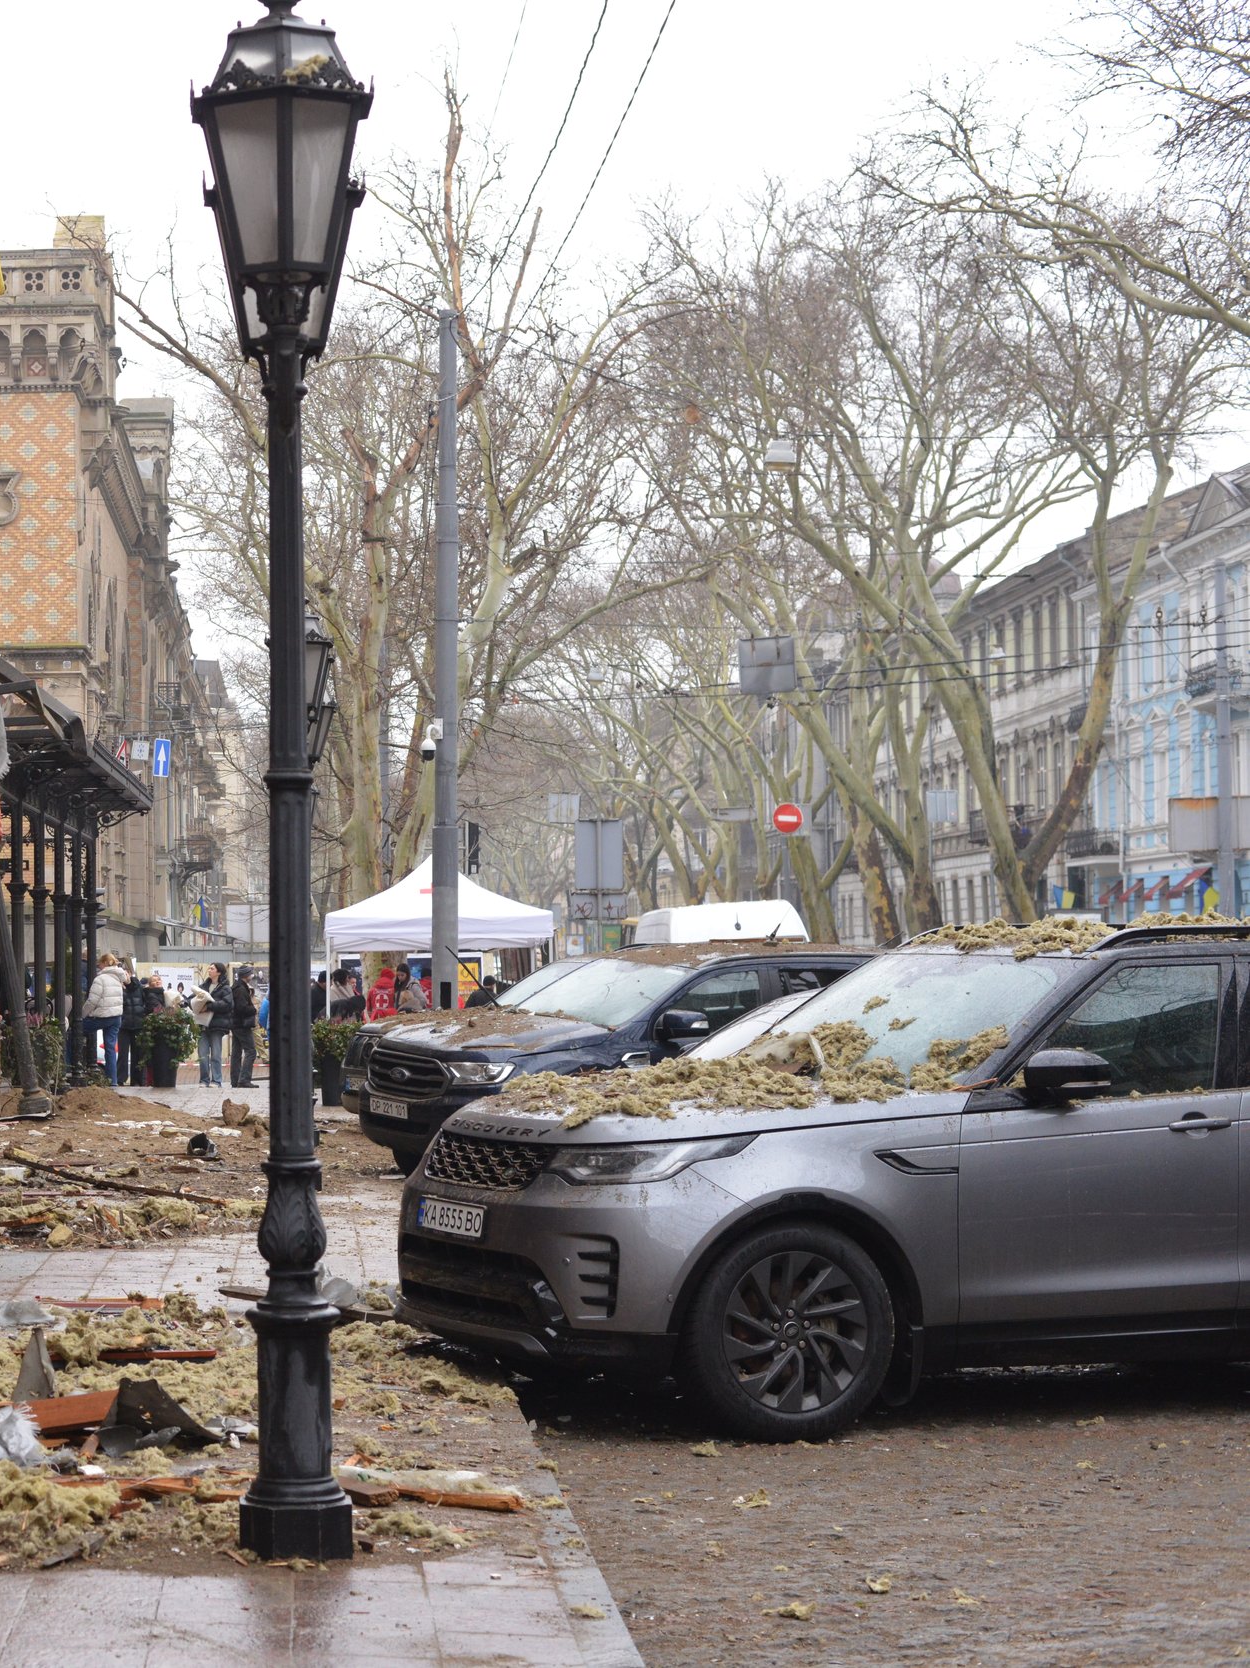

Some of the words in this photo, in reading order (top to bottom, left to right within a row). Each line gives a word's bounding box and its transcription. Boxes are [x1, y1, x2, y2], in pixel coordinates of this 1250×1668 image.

[451, 1117, 551, 1138] DISCOVERY
[423, 1203, 437, 1226] KA
[438, 1206, 463, 1230] 8555
[465, 1210, 482, 1233] BO
